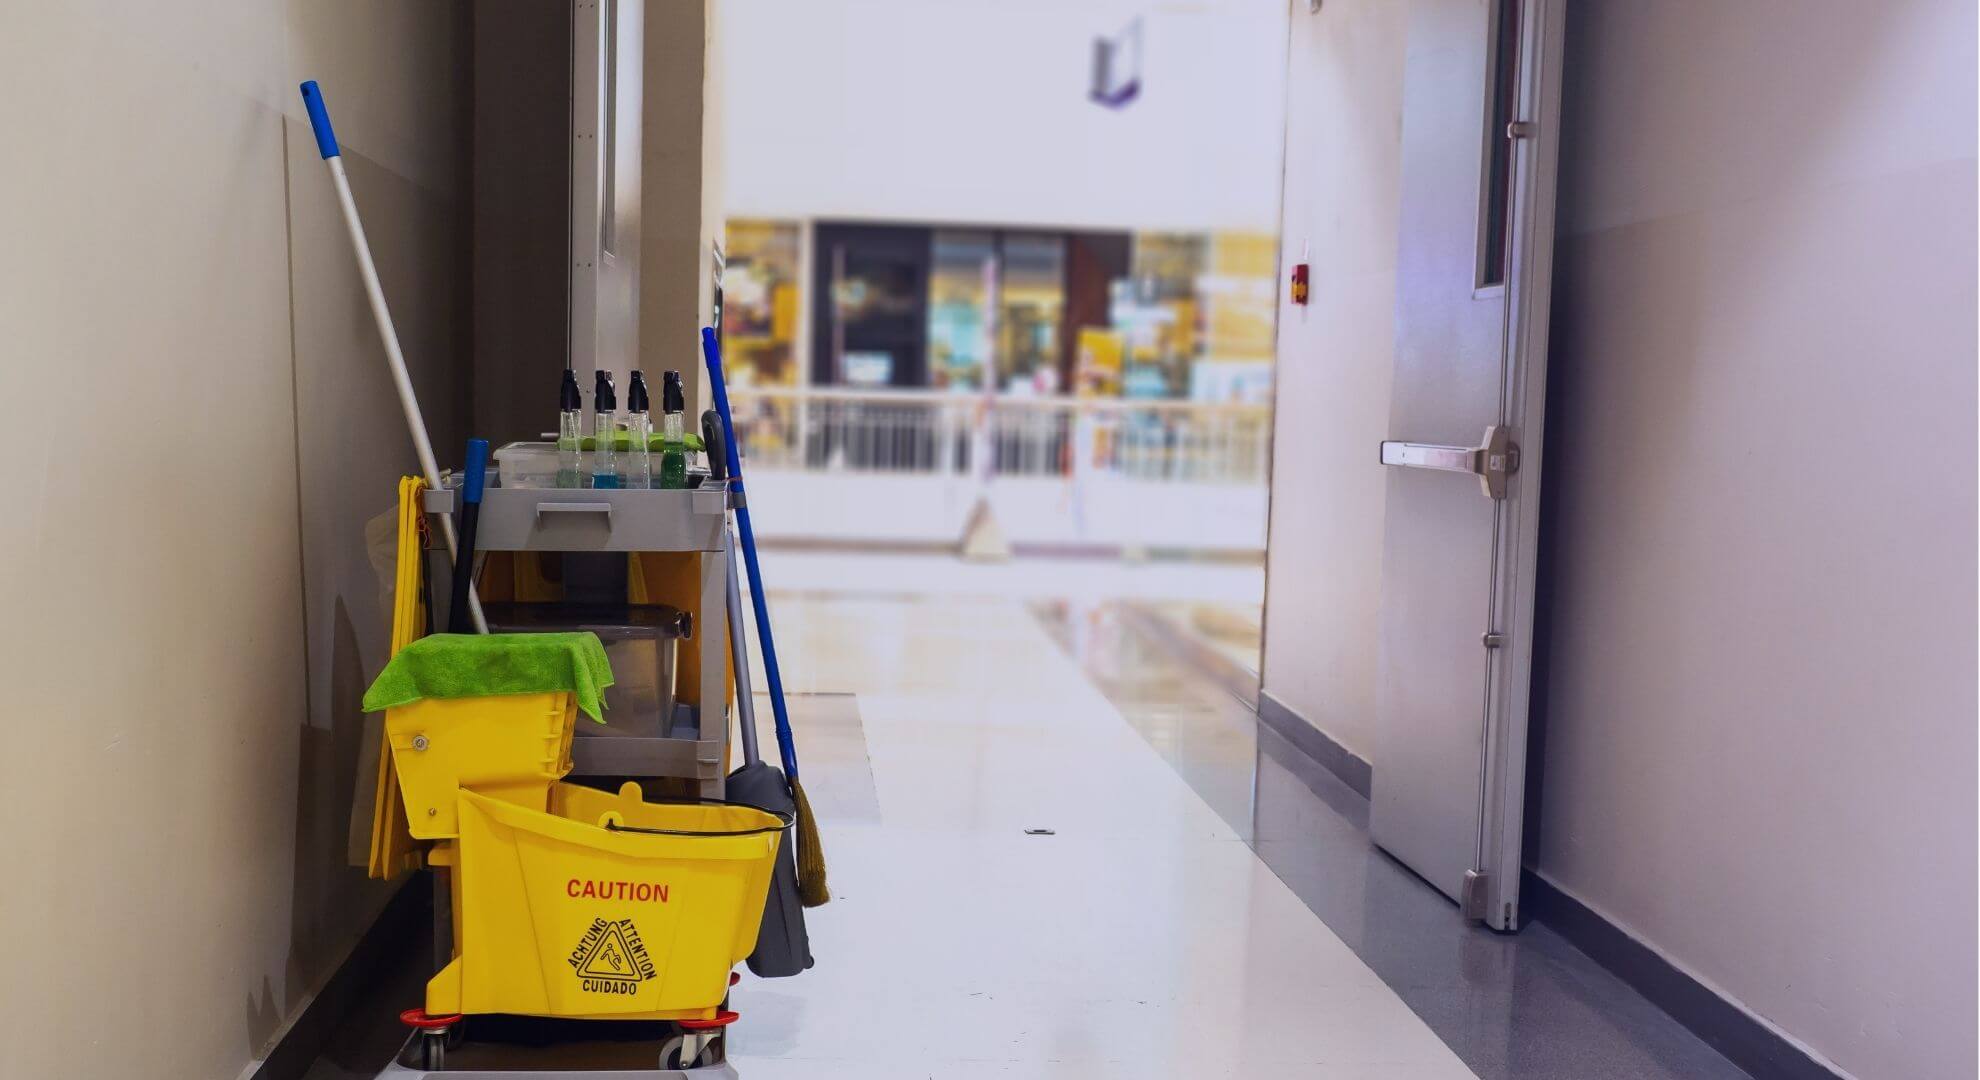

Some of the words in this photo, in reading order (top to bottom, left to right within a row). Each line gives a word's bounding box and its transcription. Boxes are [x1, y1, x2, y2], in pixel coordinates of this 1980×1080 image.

[567, 879, 669, 903] CAUTION
[568, 917, 608, 968] ACHTUNG
[619, 919, 657, 980] ATTENTION
[582, 980, 637, 995] CUIDADO
